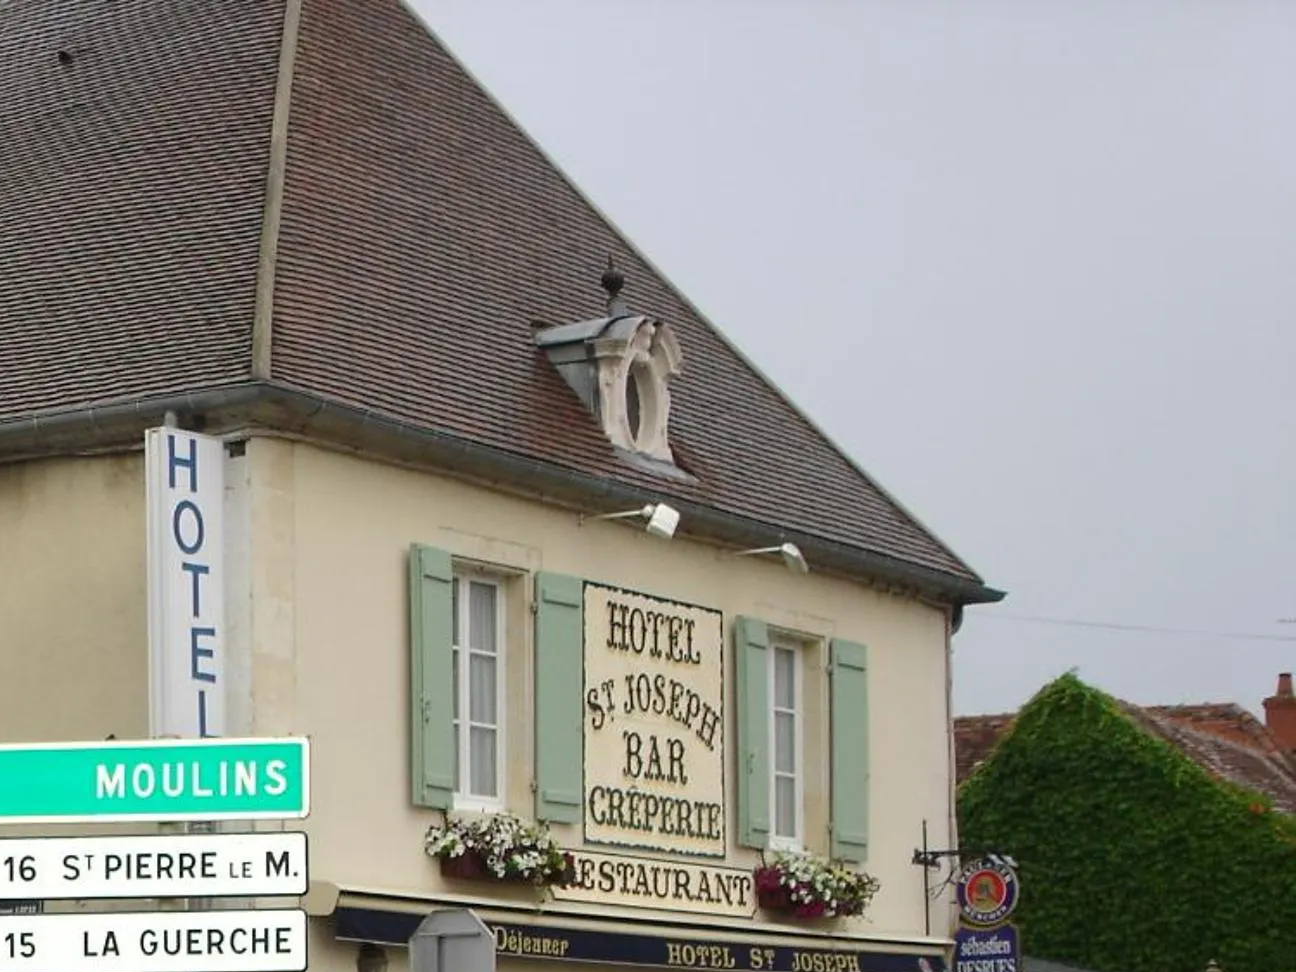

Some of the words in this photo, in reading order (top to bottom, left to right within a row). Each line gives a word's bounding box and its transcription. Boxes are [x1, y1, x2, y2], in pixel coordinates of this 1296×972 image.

[167, 434, 220, 739] HOTEL
[606, 601, 701, 665] HOTEL
[623, 673, 720, 751] JOSEPH
[95, 759, 288, 799] MOULINS
[622, 730, 689, 786] BAR
[3, 855, 37, 882] 16
[104, 851, 218, 880] PIERRE
[228, 861, 254, 878] LE
[264, 851, 300, 877] M.
[564, 857, 751, 907] ESTAURANT
[5, 932, 36, 958] 15
[83, 930, 120, 956] LA
[139, 927, 292, 956] GUERCHE
[492, 926, 569, 957] Déjeuner
[667, 943, 736, 968] HOTEL
